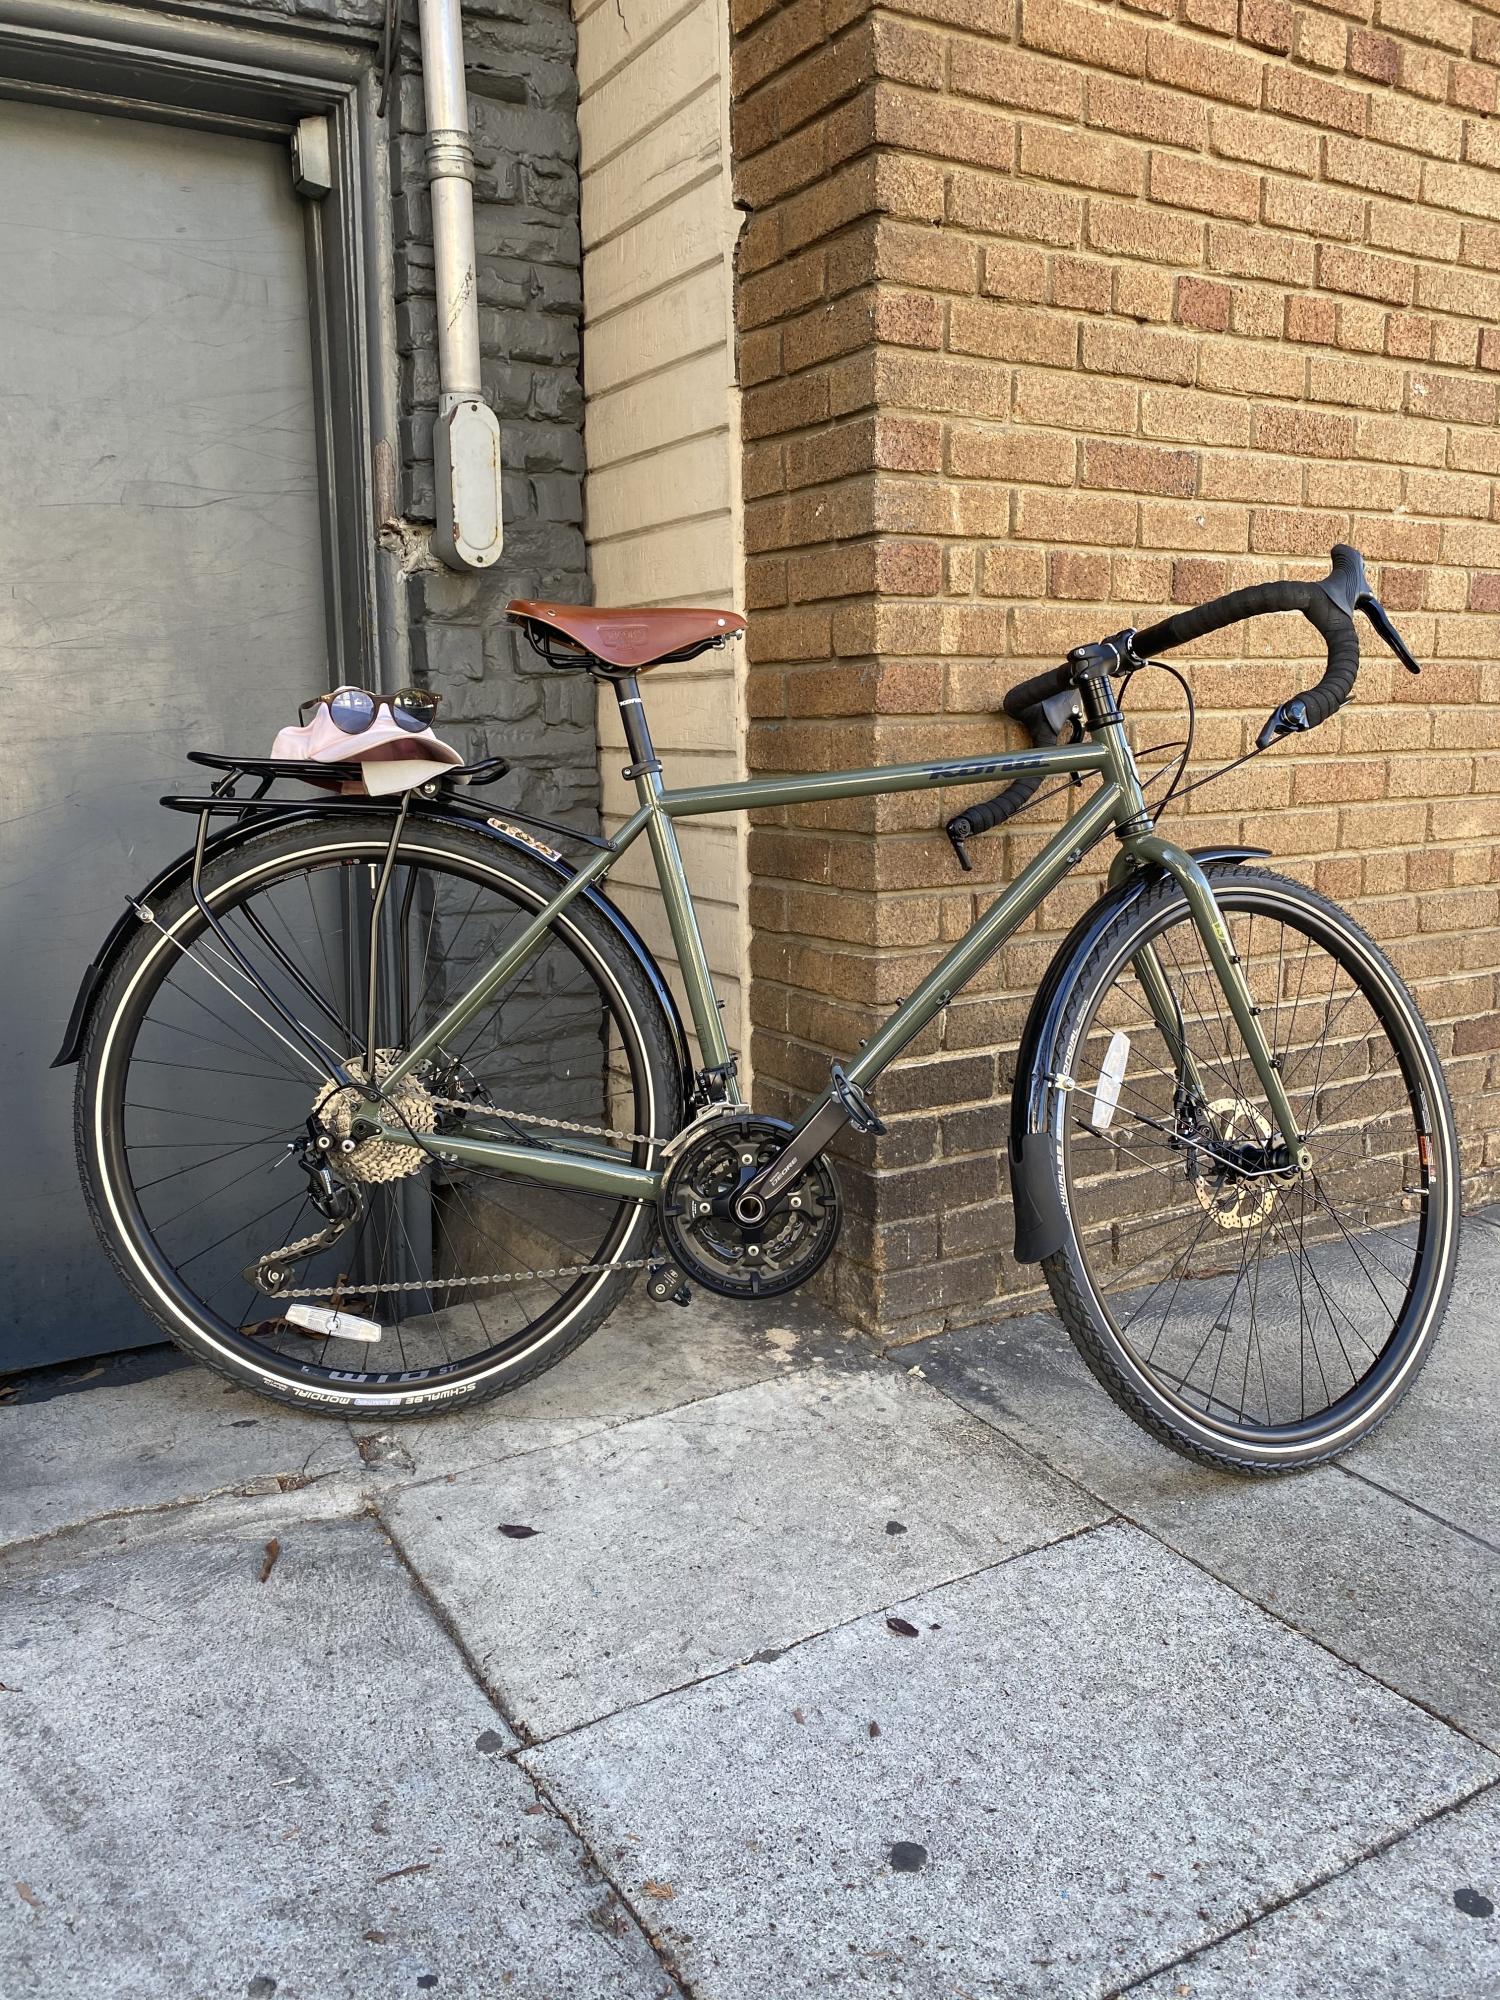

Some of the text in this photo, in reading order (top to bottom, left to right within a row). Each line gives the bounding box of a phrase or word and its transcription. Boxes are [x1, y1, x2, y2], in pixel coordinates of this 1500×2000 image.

[1063, 1028, 1079, 1076] ONDIAL
[771, 1156, 798, 1187] DEORE
[293, 1387, 350, 1405] MONDIAL
[405, 1382, 477, 1405] SCHWALBE
